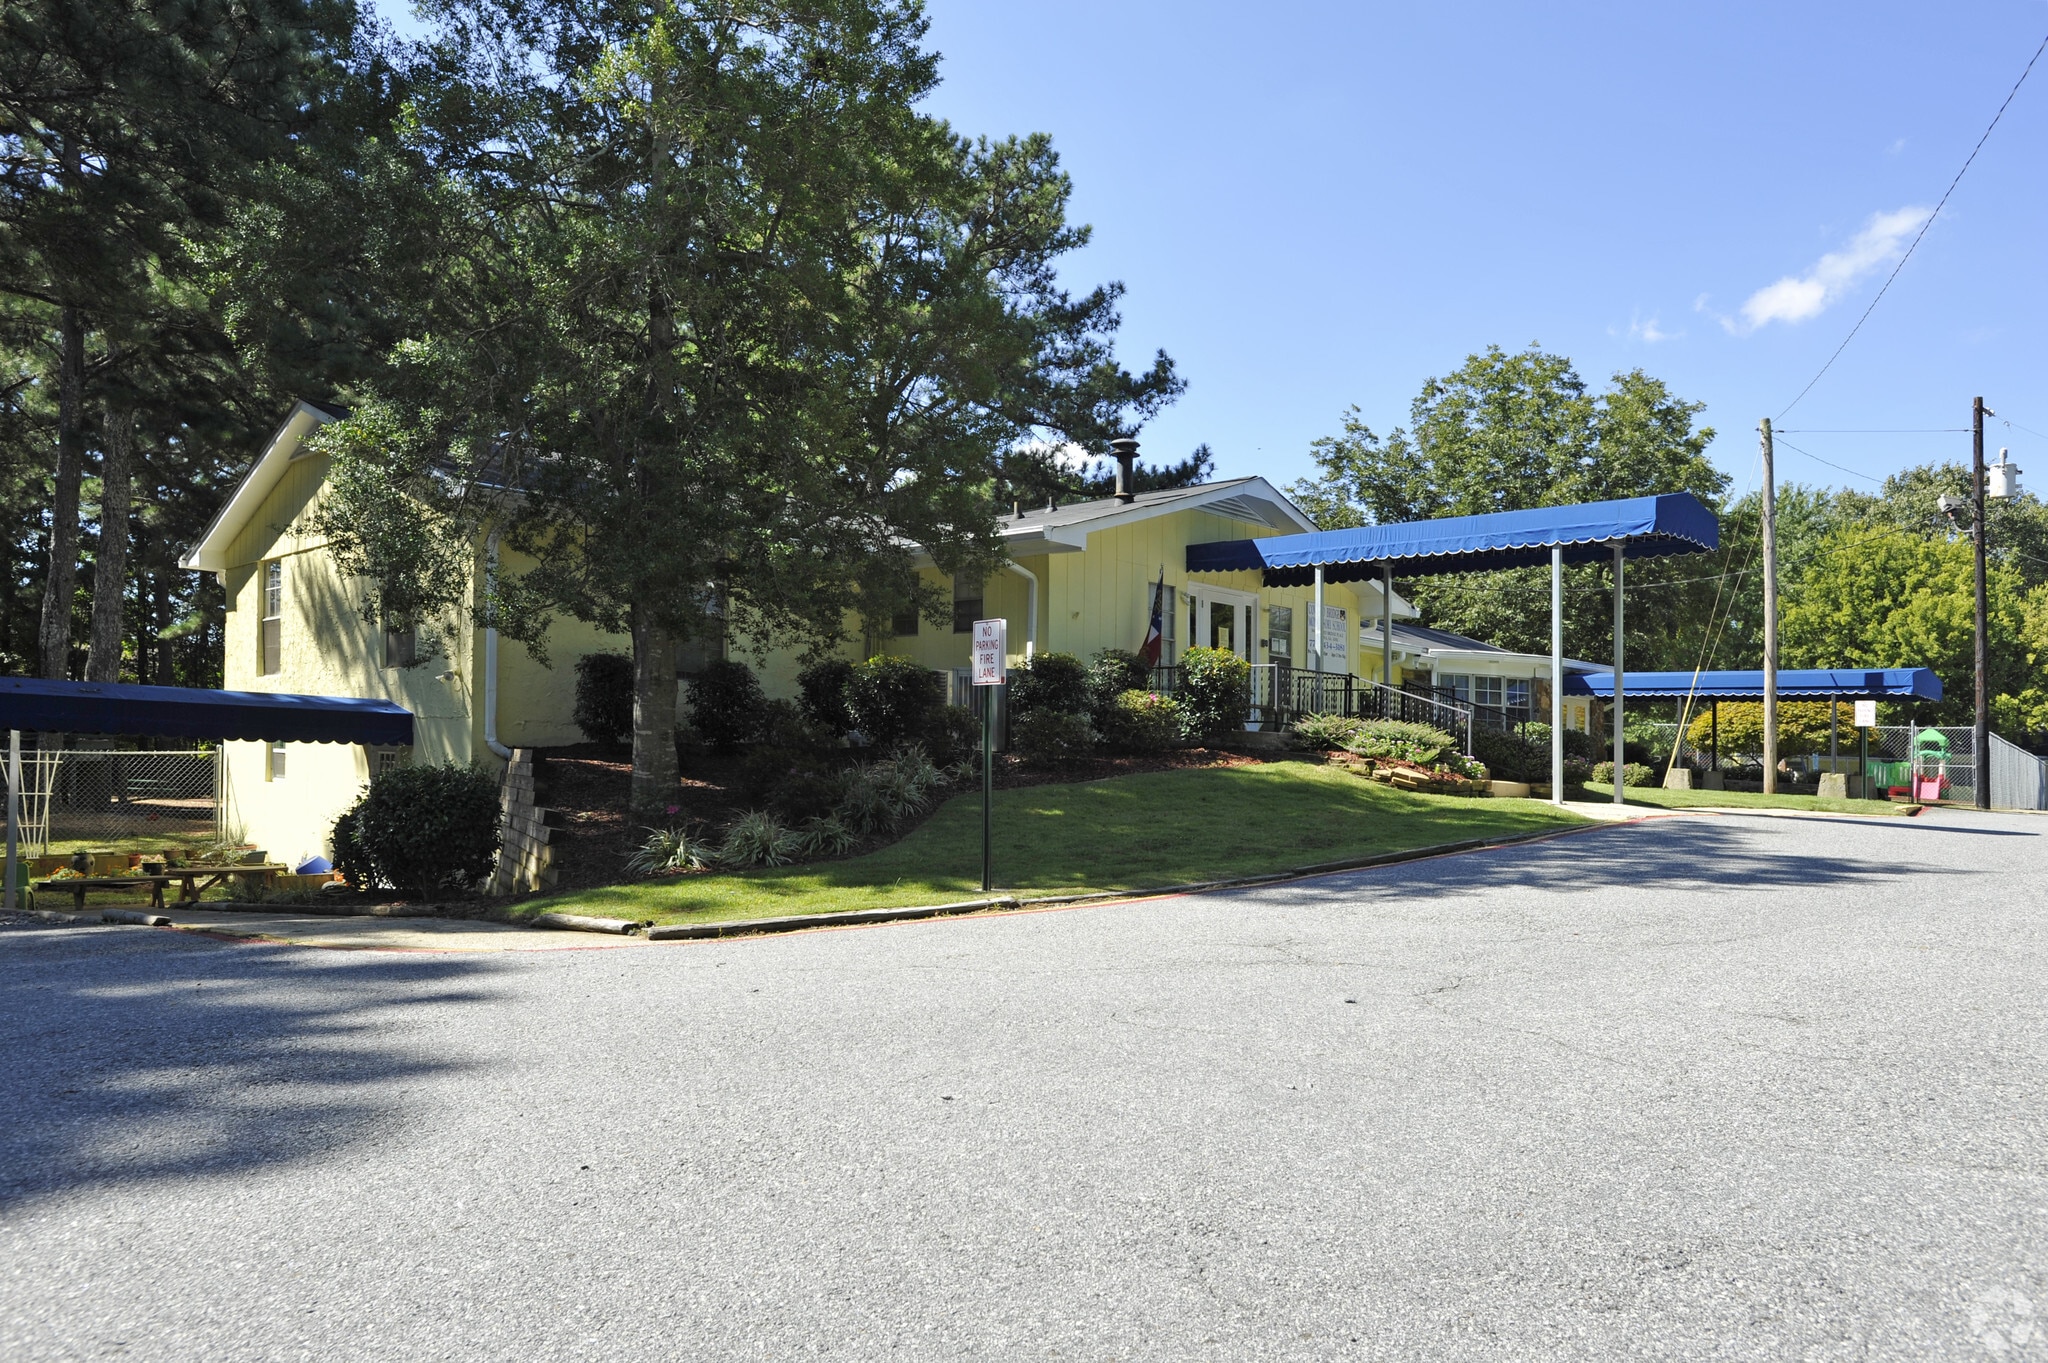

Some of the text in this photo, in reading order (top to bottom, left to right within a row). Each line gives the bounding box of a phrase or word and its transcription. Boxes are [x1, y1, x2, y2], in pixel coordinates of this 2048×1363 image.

[982, 626, 992, 637] NO
[976, 639, 999, 651] PARKING
[979, 653, 994, 665] FIRE
[978, 667, 995, 679] LANE
